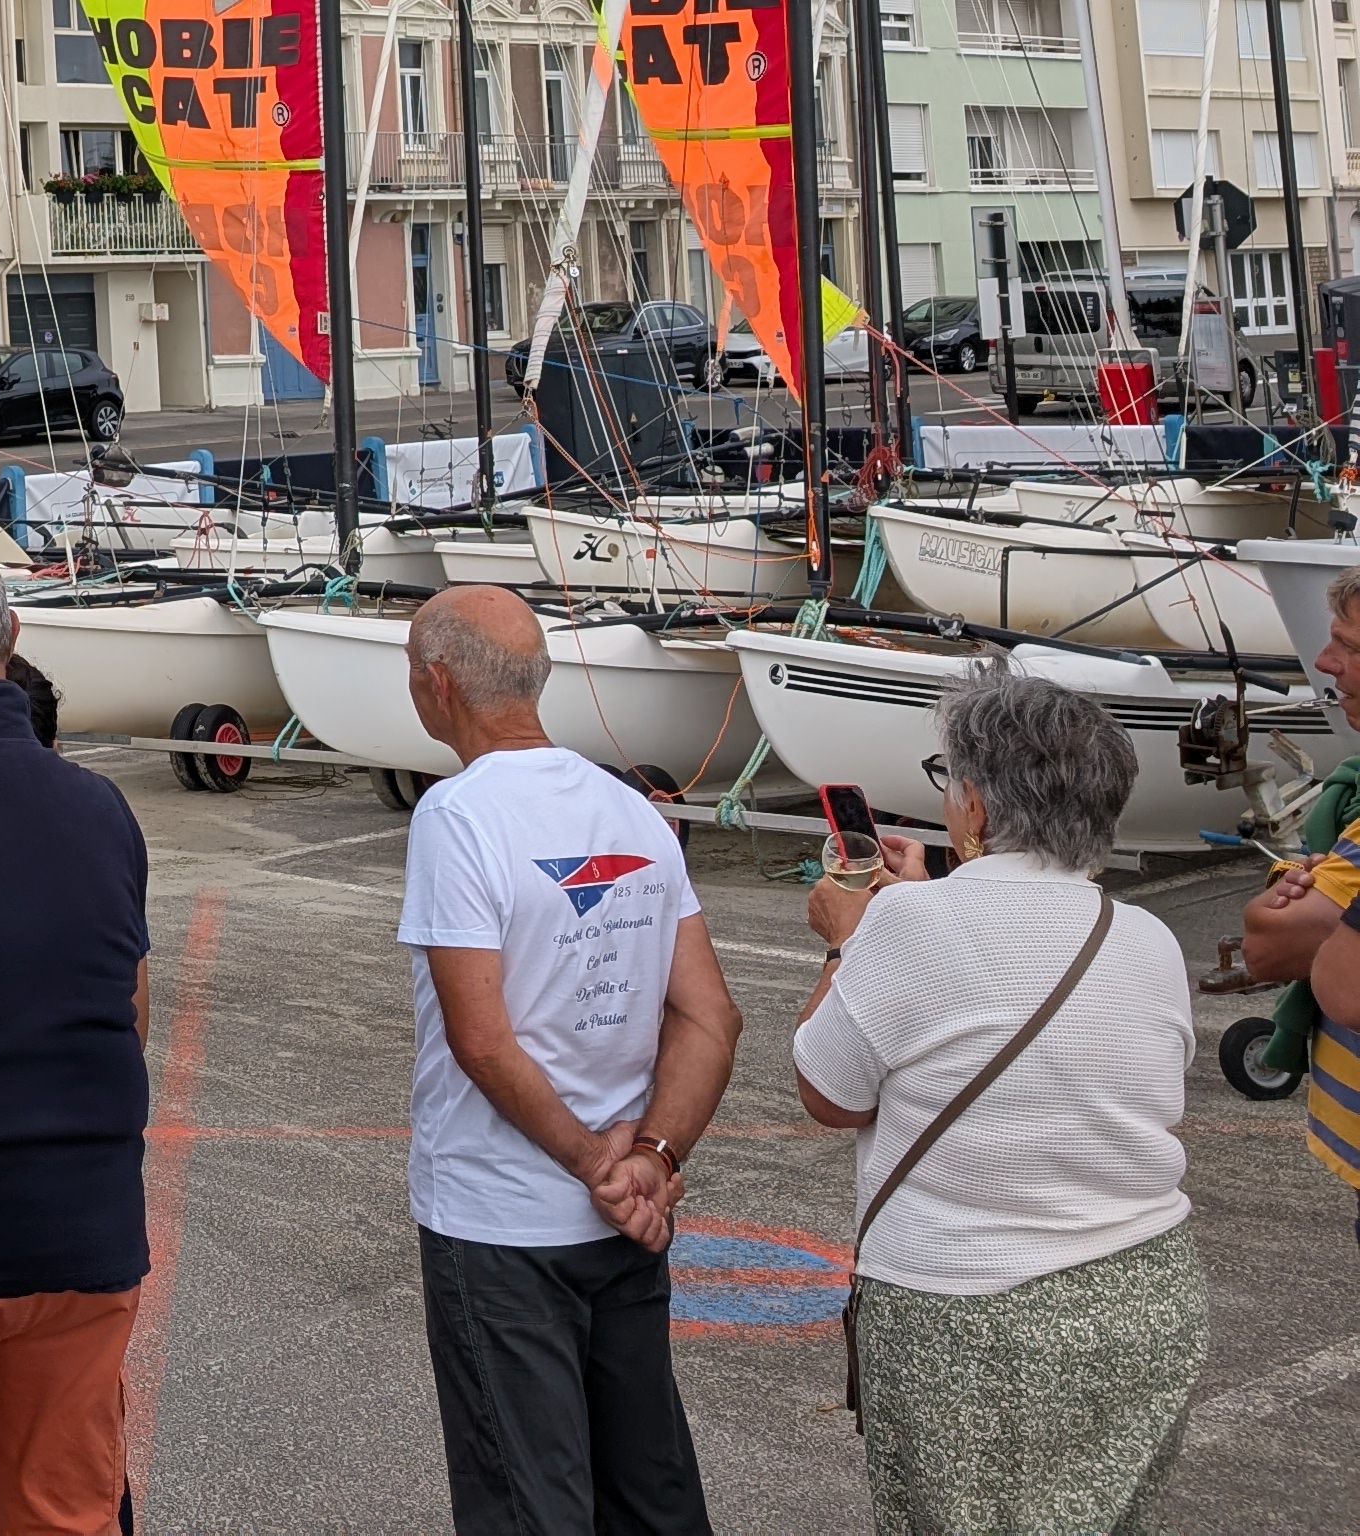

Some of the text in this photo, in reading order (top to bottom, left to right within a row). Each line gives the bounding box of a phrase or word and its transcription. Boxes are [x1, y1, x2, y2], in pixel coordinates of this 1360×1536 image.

[88, 13, 300, 69] HOBIE
[121, 74, 267, 129] CAT
[548, 861, 600, 878] Y B
[642, 882, 666, 896] 2015
[577, 892, 586, 909] C
